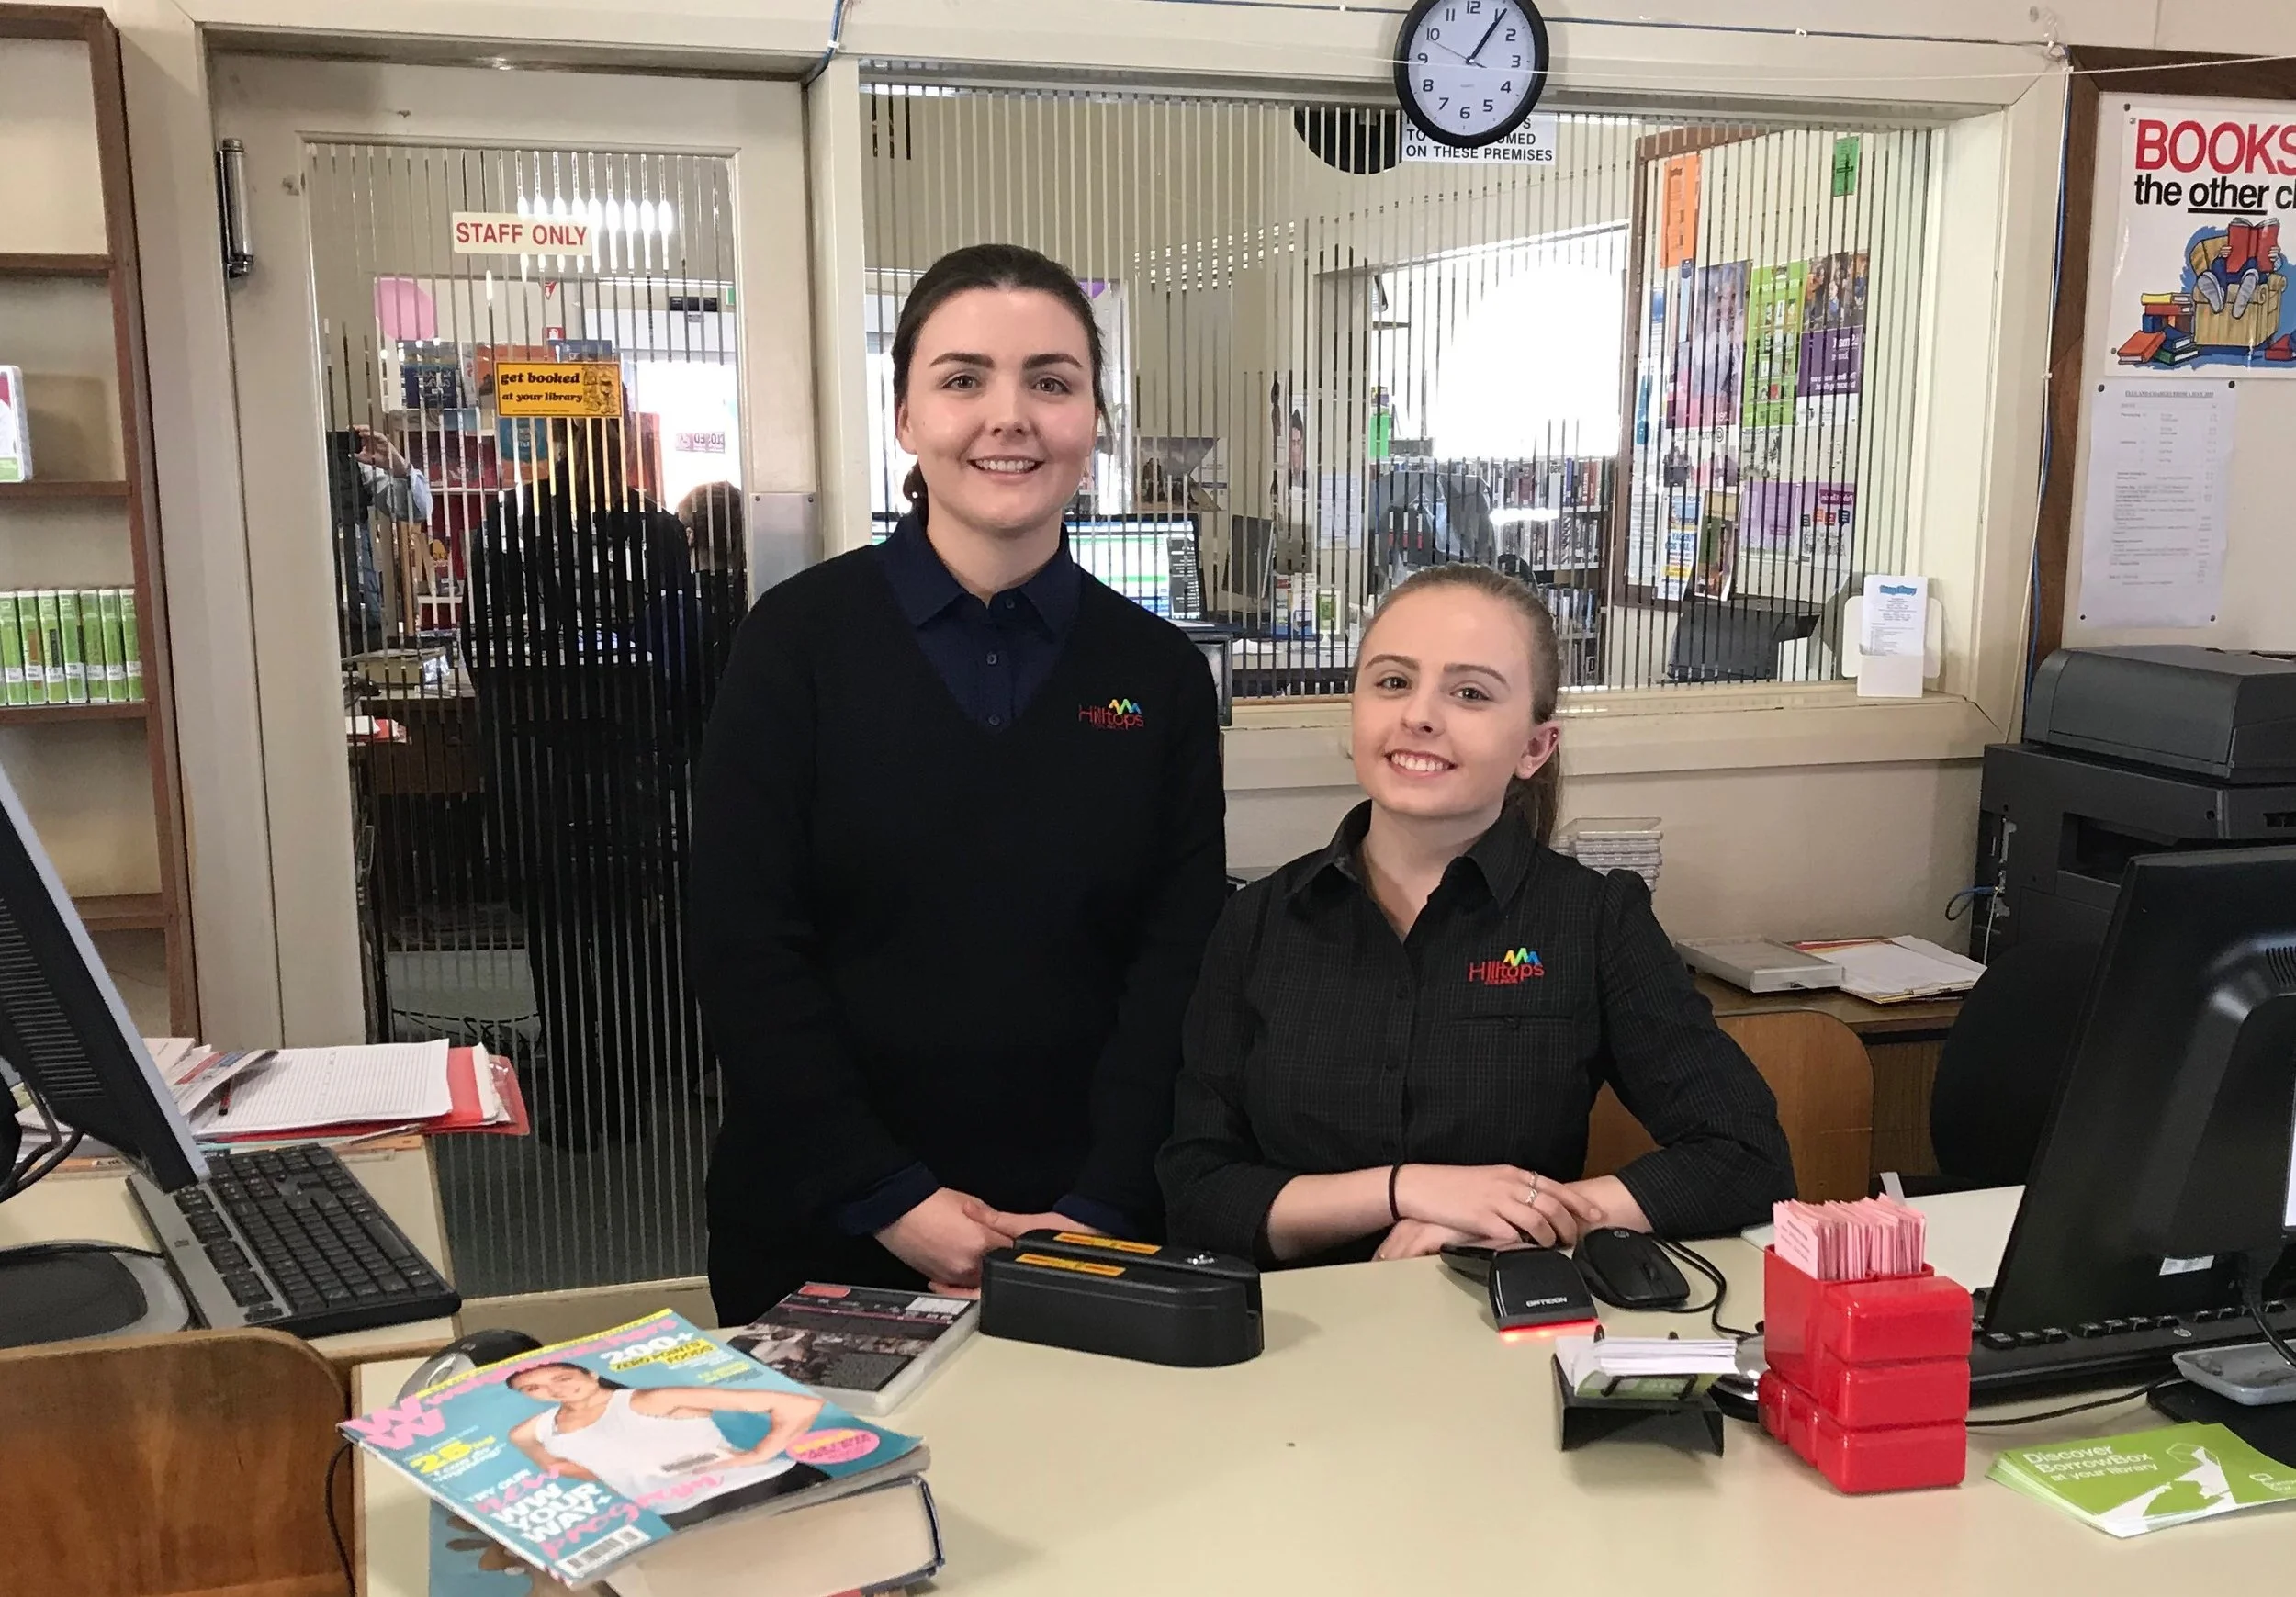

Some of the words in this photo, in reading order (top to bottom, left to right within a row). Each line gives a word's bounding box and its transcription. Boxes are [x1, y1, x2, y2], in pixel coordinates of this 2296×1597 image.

[1467, 1, 1480, 14] 12
[1446, 8, 1455, 21] 11
[1426, 28, 1440, 40] 10
[1506, 28, 1516, 41] 2
[1418, 53, 1428, 63] 9
[1512, 55, 1521, 68] 3
[1424, 79, 1434, 92] 8
[1501, 81, 1511, 93] 4
[1439, 97, 1449, 110] 7
[1483, 99, 1493, 112] 5
[1460, 107, 1470, 119] 6
[1406, 145, 1427, 157] ON
[1434, 146, 1479, 159] THESE
[1484, 148, 1553, 161] PREMISES
[2135, 119, 2296, 176] BOOKS
[2134, 174, 2182, 206] the
[2189, 176, 2269, 208] other
[456, 222, 523, 244] STAFF
[532, 224, 587, 245] ONLY
[500, 373, 524, 385] get
[527, 372, 580, 384] booked
[501, 392, 514, 401] at
[516, 394, 542, 403] your
[544, 392, 582, 403] library
[1078, 704, 1144, 730] Hilltops
[1469, 961, 1545, 983] Hilltops
[600, 1332, 694, 1366] 200+
[2022, 1445, 2113, 1465] Discover
[2034, 1452, 2154, 1474] BorrowBox
[2070, 1470, 2106, 1480] your
[2106, 1463, 2158, 1475] library
[505, 1482, 602, 1531] YOUR
